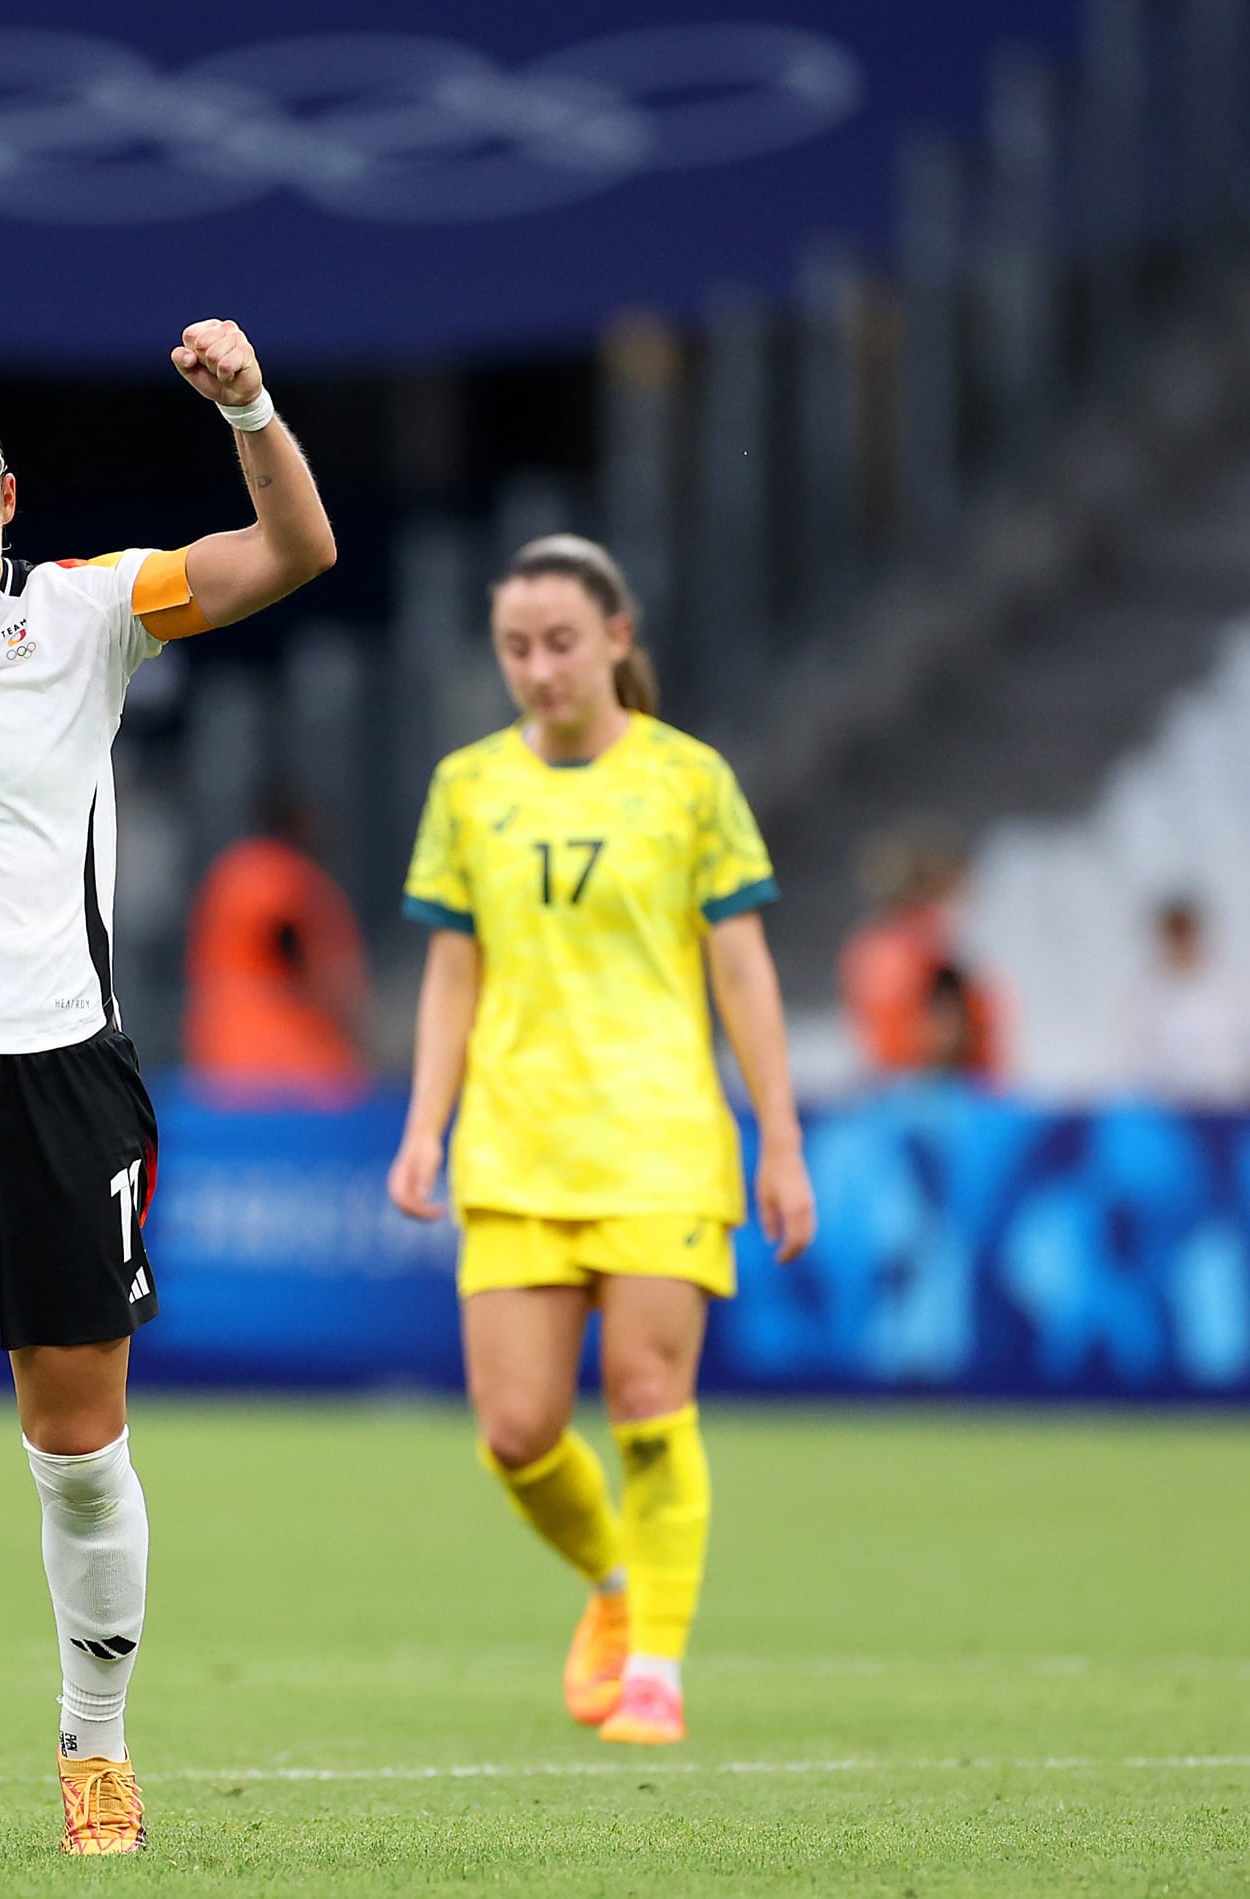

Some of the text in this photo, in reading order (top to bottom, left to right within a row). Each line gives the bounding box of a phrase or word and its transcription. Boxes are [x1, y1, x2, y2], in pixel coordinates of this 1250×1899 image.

[0, 618, 27, 638] TEAM
[531, 838, 605, 905] 17
[110, 1159, 142, 1263] 11
